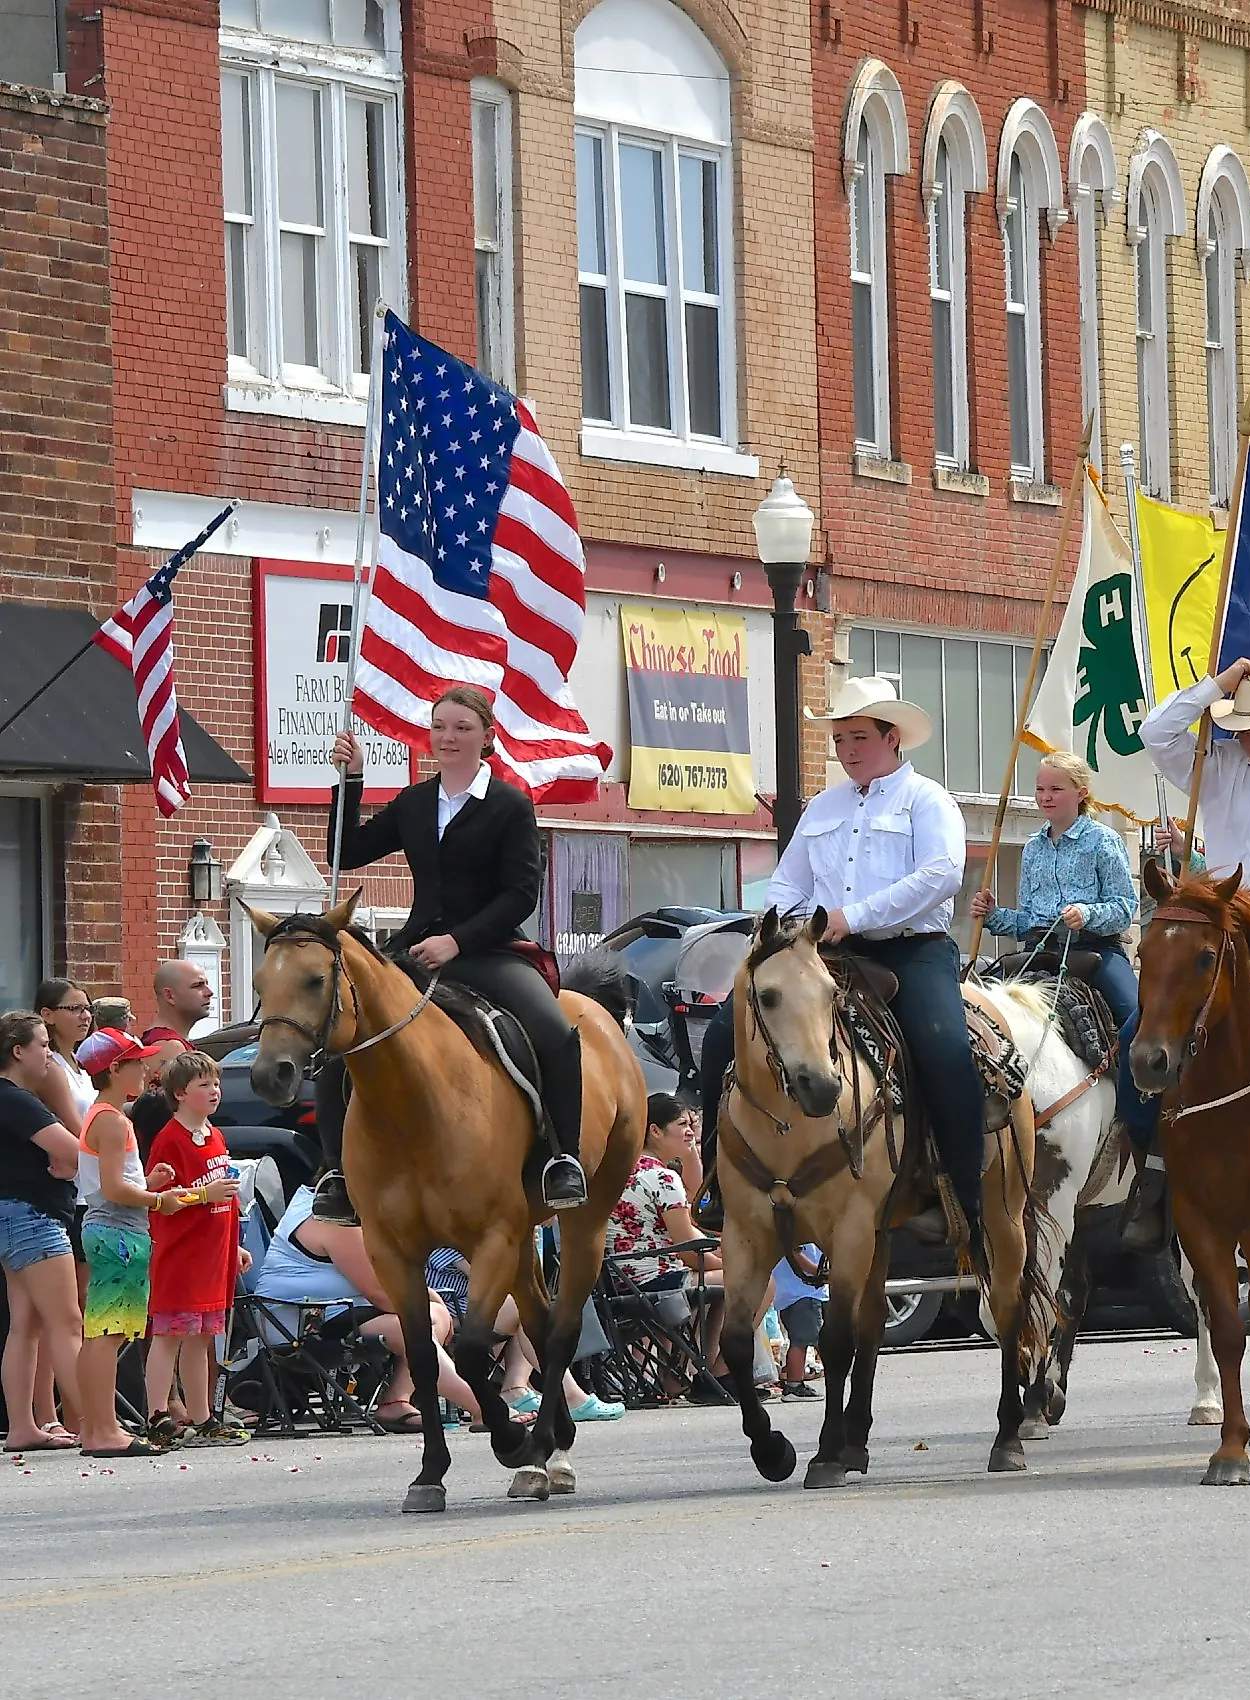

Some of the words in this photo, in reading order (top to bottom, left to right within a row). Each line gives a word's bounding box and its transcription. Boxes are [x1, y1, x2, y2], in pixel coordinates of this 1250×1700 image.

[629, 623, 696, 676] Chinese
[702, 628, 742, 680] Food
[296, 675, 329, 702] FARM
[653, 700, 670, 721] Eat
[679, 709, 690, 722] or
[691, 702, 712, 725] Take
[712, 711, 726, 725] out
[268, 740, 289, 765] Alex
[365, 742, 409, 766] 767-6834
[658, 764, 684, 792] (620)
[685, 766, 728, 790] 767-7373
